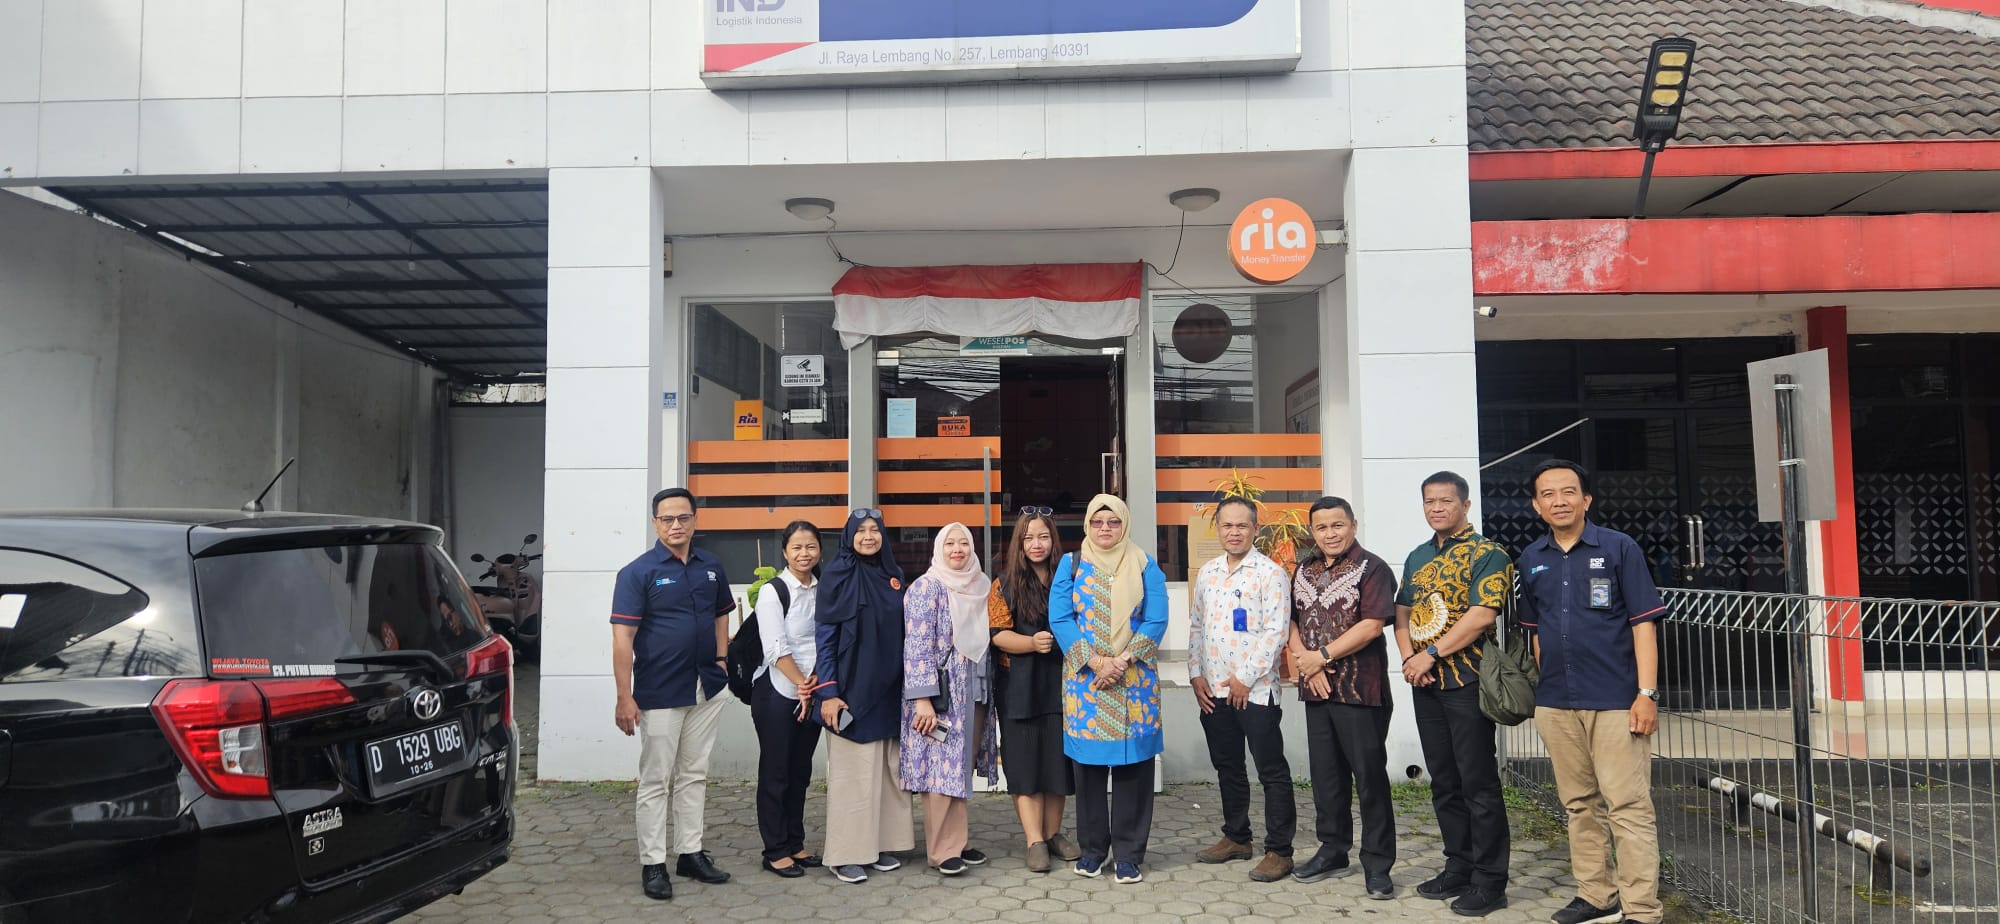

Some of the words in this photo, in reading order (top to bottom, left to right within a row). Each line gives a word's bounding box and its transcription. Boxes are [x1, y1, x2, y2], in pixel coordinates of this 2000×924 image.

[716, 16, 753, 28] Logistik
[755, 15, 803, 25] Indonesia
[836, 50, 869, 67] Raya
[872, 48, 930, 65] Lembang
[959, 47, 986, 62] 257,
[990, 45, 1048, 61] Lembang
[1051, 43, 1090, 57] 40391
[1241, 207, 1307, 251] ria
[1241, 255, 1269, 265] Money
[1271, 253, 1306, 264] Transfer
[738, 412, 758, 424] Ria
[285, 664, 309, 676] PUTRA
[371, 745, 383, 773] D
[396, 733, 430, 765] 1529
[434, 725, 461, 753] UBG
[303, 807, 342, 827] ASTRA
